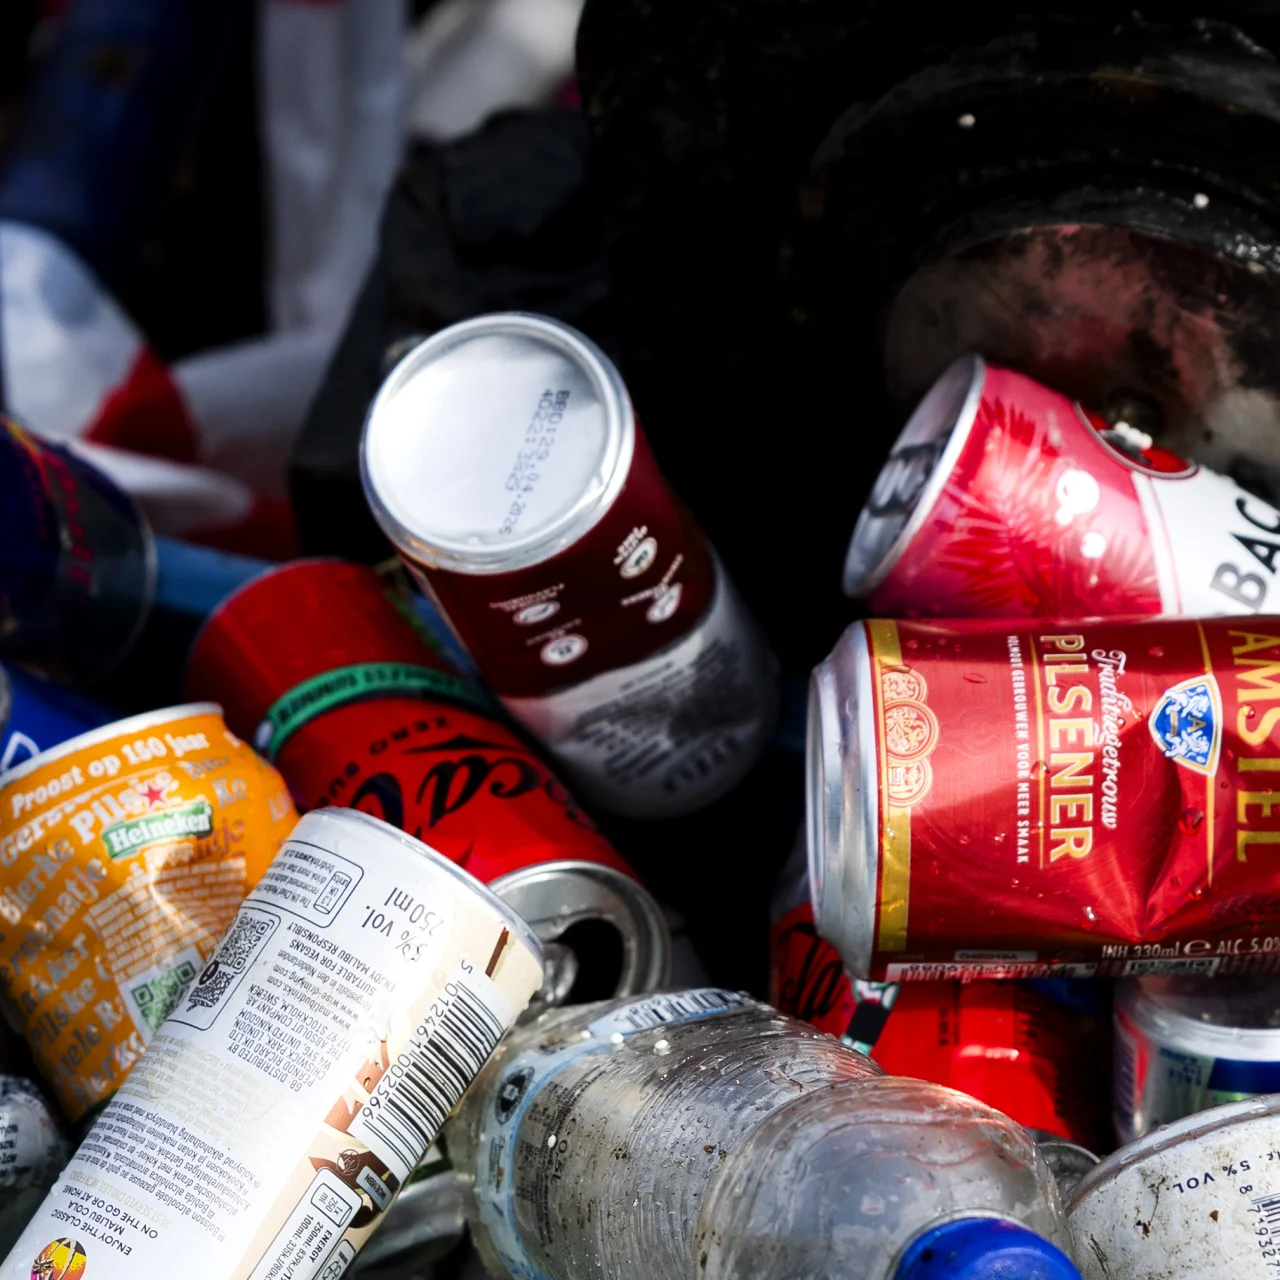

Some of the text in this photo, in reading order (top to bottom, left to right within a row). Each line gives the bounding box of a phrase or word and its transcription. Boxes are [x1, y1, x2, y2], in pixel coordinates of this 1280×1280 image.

[1013, 669, 1028, 738] GEBROUWEN
[370, 716, 448, 755] ZERO
[1040, 634, 1093, 862] PILSENER
[1091, 649, 1131, 828] Traditiegetrouw
[10, 722, 209, 817] Proost op 150 jaar
[1015, 743, 1028, 778] VOOR
[1016, 782, 1029, 814] MEER
[106, 802, 214, 859] Heineken
[1016, 820, 1028, 862] SMAAK
[355, 903, 396, 940] vol.
[383, 885, 446, 935] 250 ml
[286, 918, 339, 957] RESPONSIBLY
[288, 936, 377, 997] SUITABLE FOR VEGANS
[336, 948, 371, 976] MALIBU
[247, 981, 280, 1007] SWEDEN
[265, 972, 352, 1032] www.malibudrinks.com
[272, 961, 360, 1022] www.wise-drinking.com
[244, 991, 343, 1059] THE ABSOLUT COMPANY AB,
[276, 998, 329, 1037] STOCKHOLM,
[325, 1030, 340, 1044] 97
[227, 1028, 315, 1086] PERNOD RICARD UK LTD
[230, 1015, 327, 1080] CHISWICK PARK, LONDON,
[238, 1006, 333, 1069] W4 5YG, UNITED KINGDOM
[359, 958, 474, 1124] 5 012461 002566
[226, 1041, 303, 1092] GB: DISTRIBUTED BY
[1223, 1159, 1250, 1177] 5%
[79, 1190, 92, 1202] AT
[89, 1195, 105, 1210] OR
[104, 1203, 121, 1217] GO
[50, 1205, 133, 1256] ENJOY THE CLASSIC
[66, 1199, 125, 1236] MALIBU COLA
[119, 1210, 140, 1228] THE
[139, 1222, 159, 1239] ON
[290, 1212, 313, 1241] 100ml:
[300, 1219, 323, 1249] 250ml:
[1238, 1184, 1253, 1194] 8
[1246, 1205, 1280, 1269] 719327
[305, 1228, 333, 1263] ENERGY
